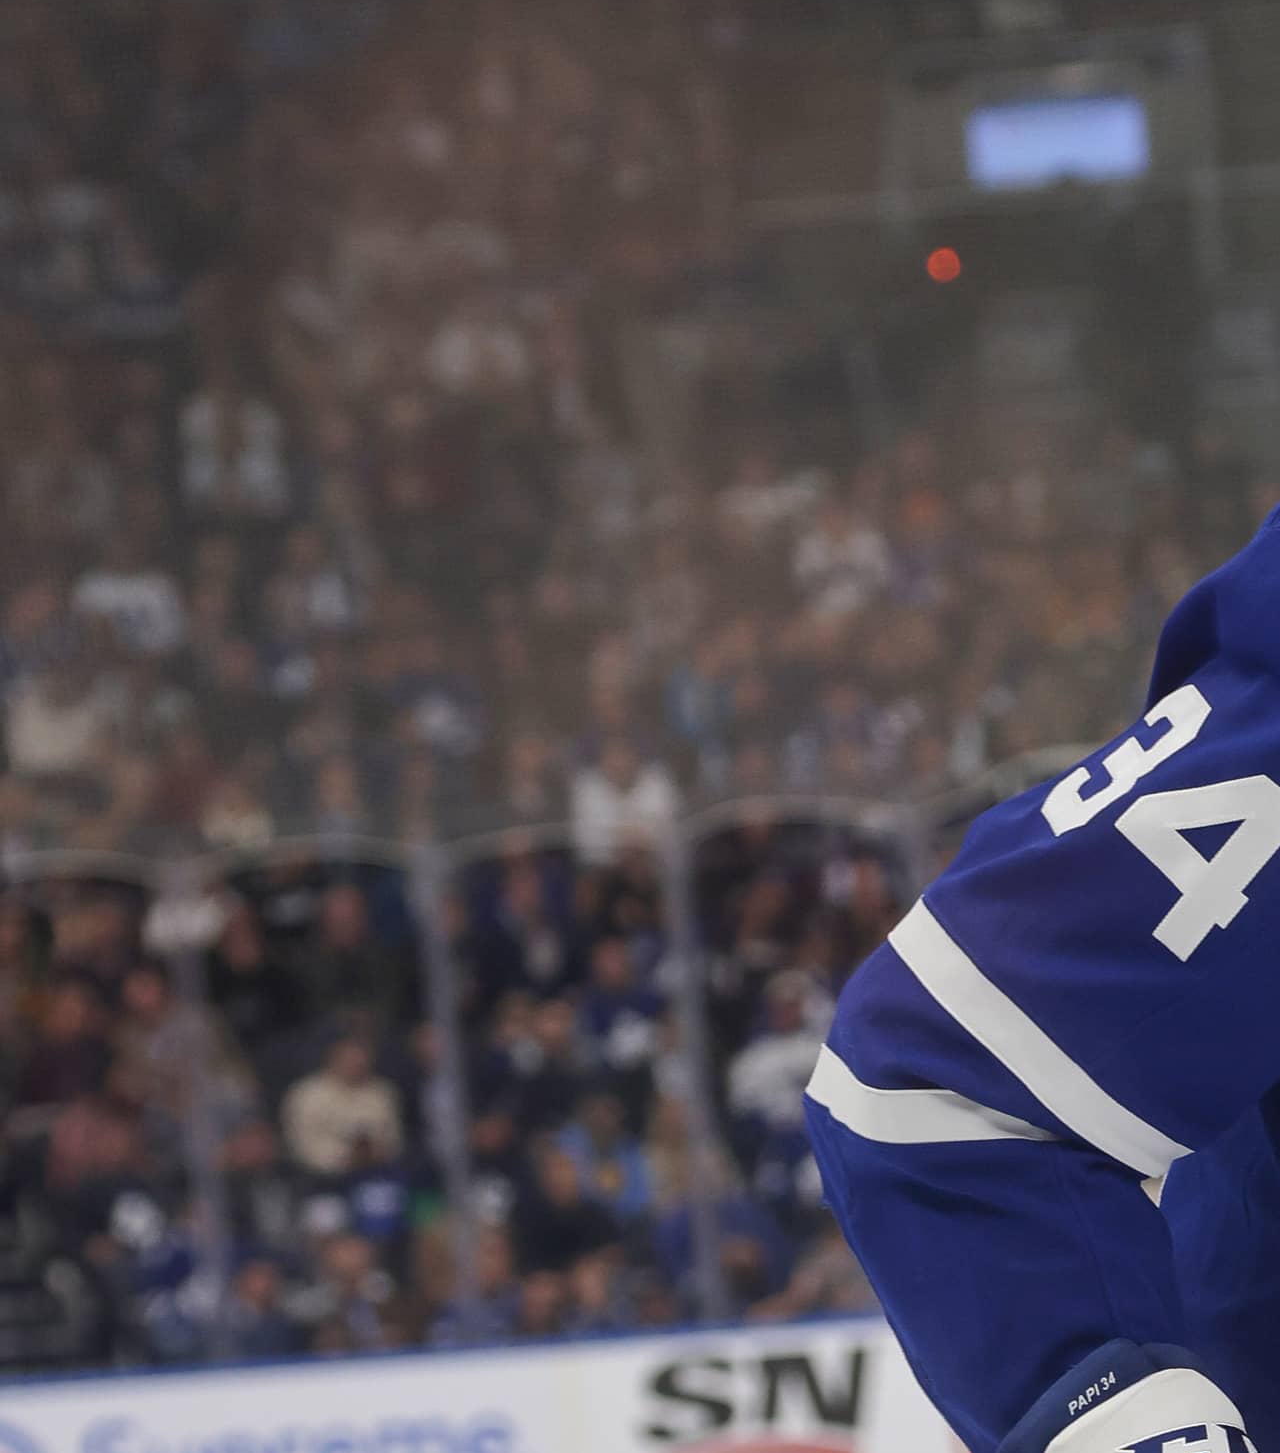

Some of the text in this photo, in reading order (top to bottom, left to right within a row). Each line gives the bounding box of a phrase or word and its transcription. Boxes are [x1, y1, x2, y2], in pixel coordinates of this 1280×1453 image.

[640, 1344, 870, 1445] SN
[1067, 1371, 1116, 1416] PAPI 34
